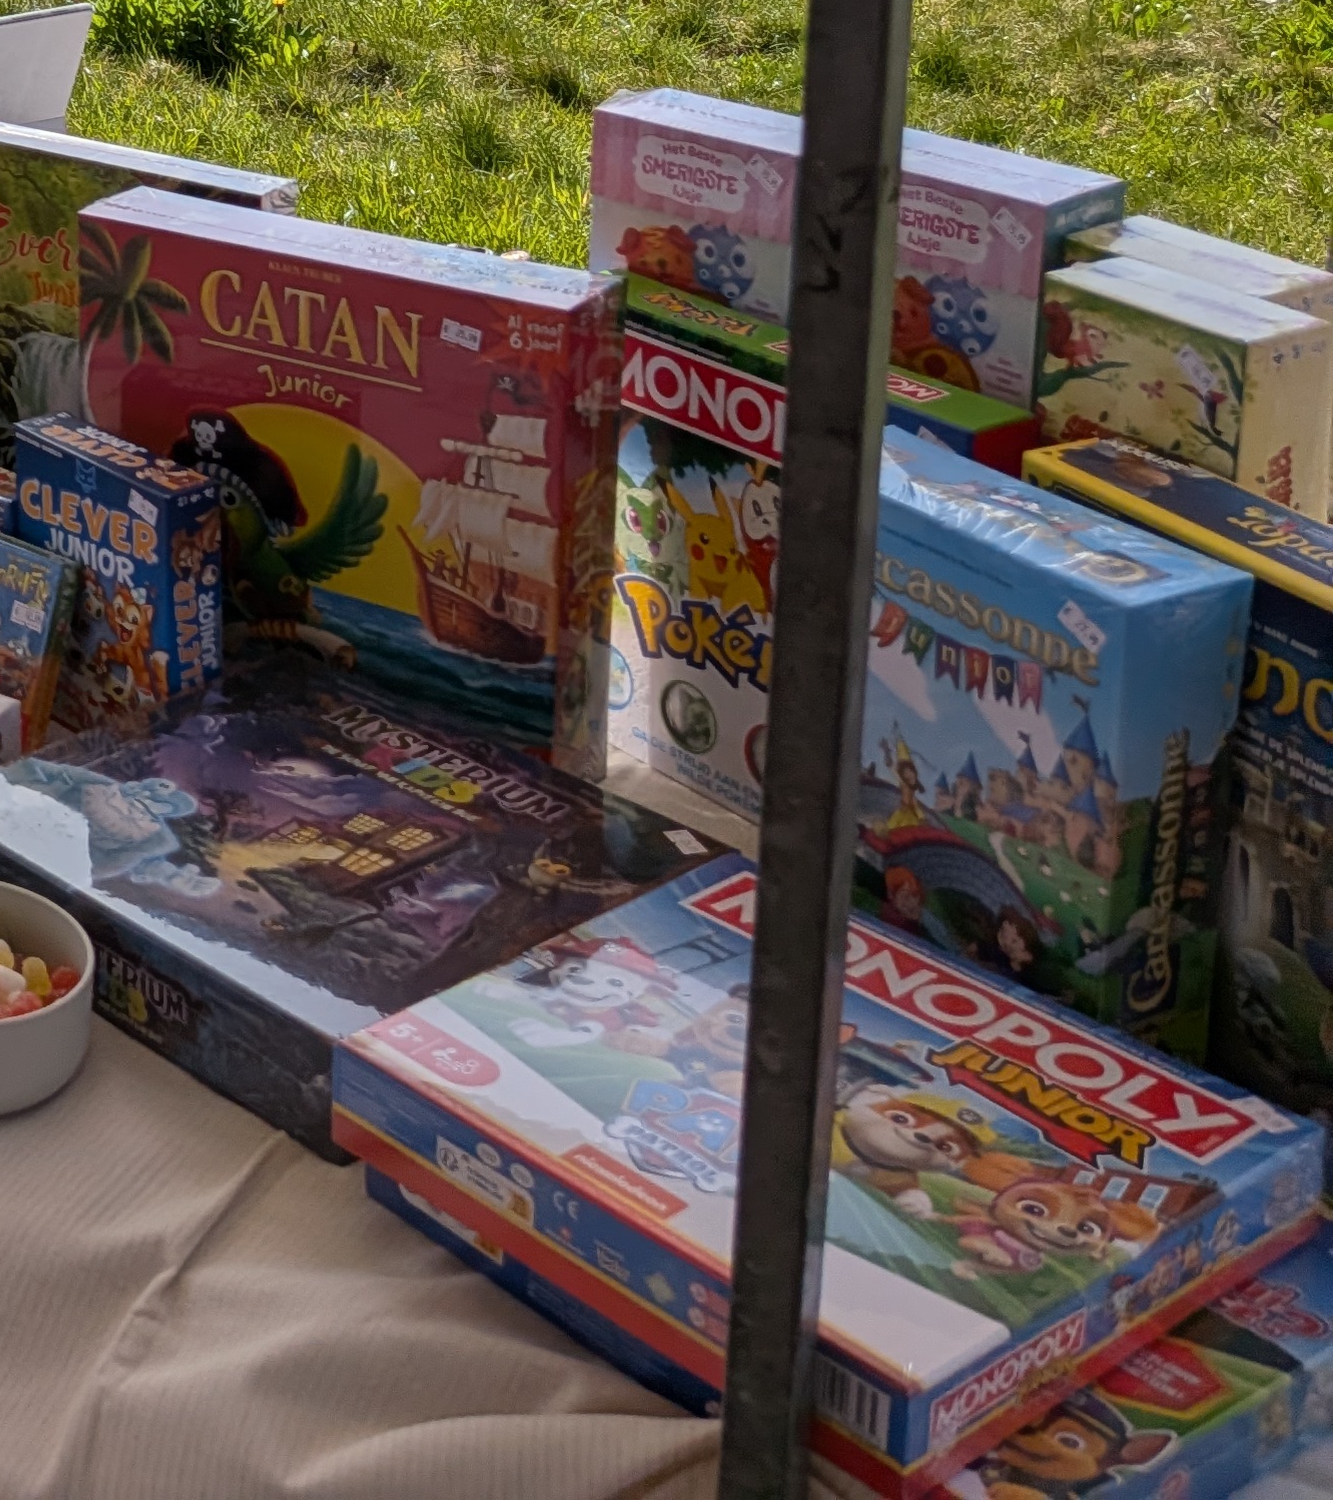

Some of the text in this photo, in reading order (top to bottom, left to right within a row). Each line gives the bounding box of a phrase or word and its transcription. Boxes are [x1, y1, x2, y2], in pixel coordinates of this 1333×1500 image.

[640, 155, 740, 196] SMERIGSTE
[662, 143, 724, 168] Het Beste
[899, 205, 981, 246] ERIGSTE
[925, 190, 965, 216] Beste
[199, 268, 425, 381] CATAN
[509, 331, 523, 349] 6
[257, 366, 353, 411] Junior
[622, 347, 786, 455] MONO
[20, 479, 160, 565] CLEVER
[44, 527, 136, 587] JUNIOR
[613, 574, 774, 693] Poké
[876, 550, 1101, 687] cassonne
[323, 705, 571, 822] MYSTERIUM
[363, 742, 483, 804] KIDS
[1126, 727, 1190, 1012] Carcassonne
[96, 944, 189, 1025] TERIUM
[388, 1022, 422, 1044] 5+
[625, 1079, 740, 1153] PA
[932, 1041, 1157, 1164] JUNIOR
[571, 1152, 669, 1212] nickelodeon
[629, 1125, 720, 1183] PATROL
[934, 1315, 1082, 1439] MONOPOLY
